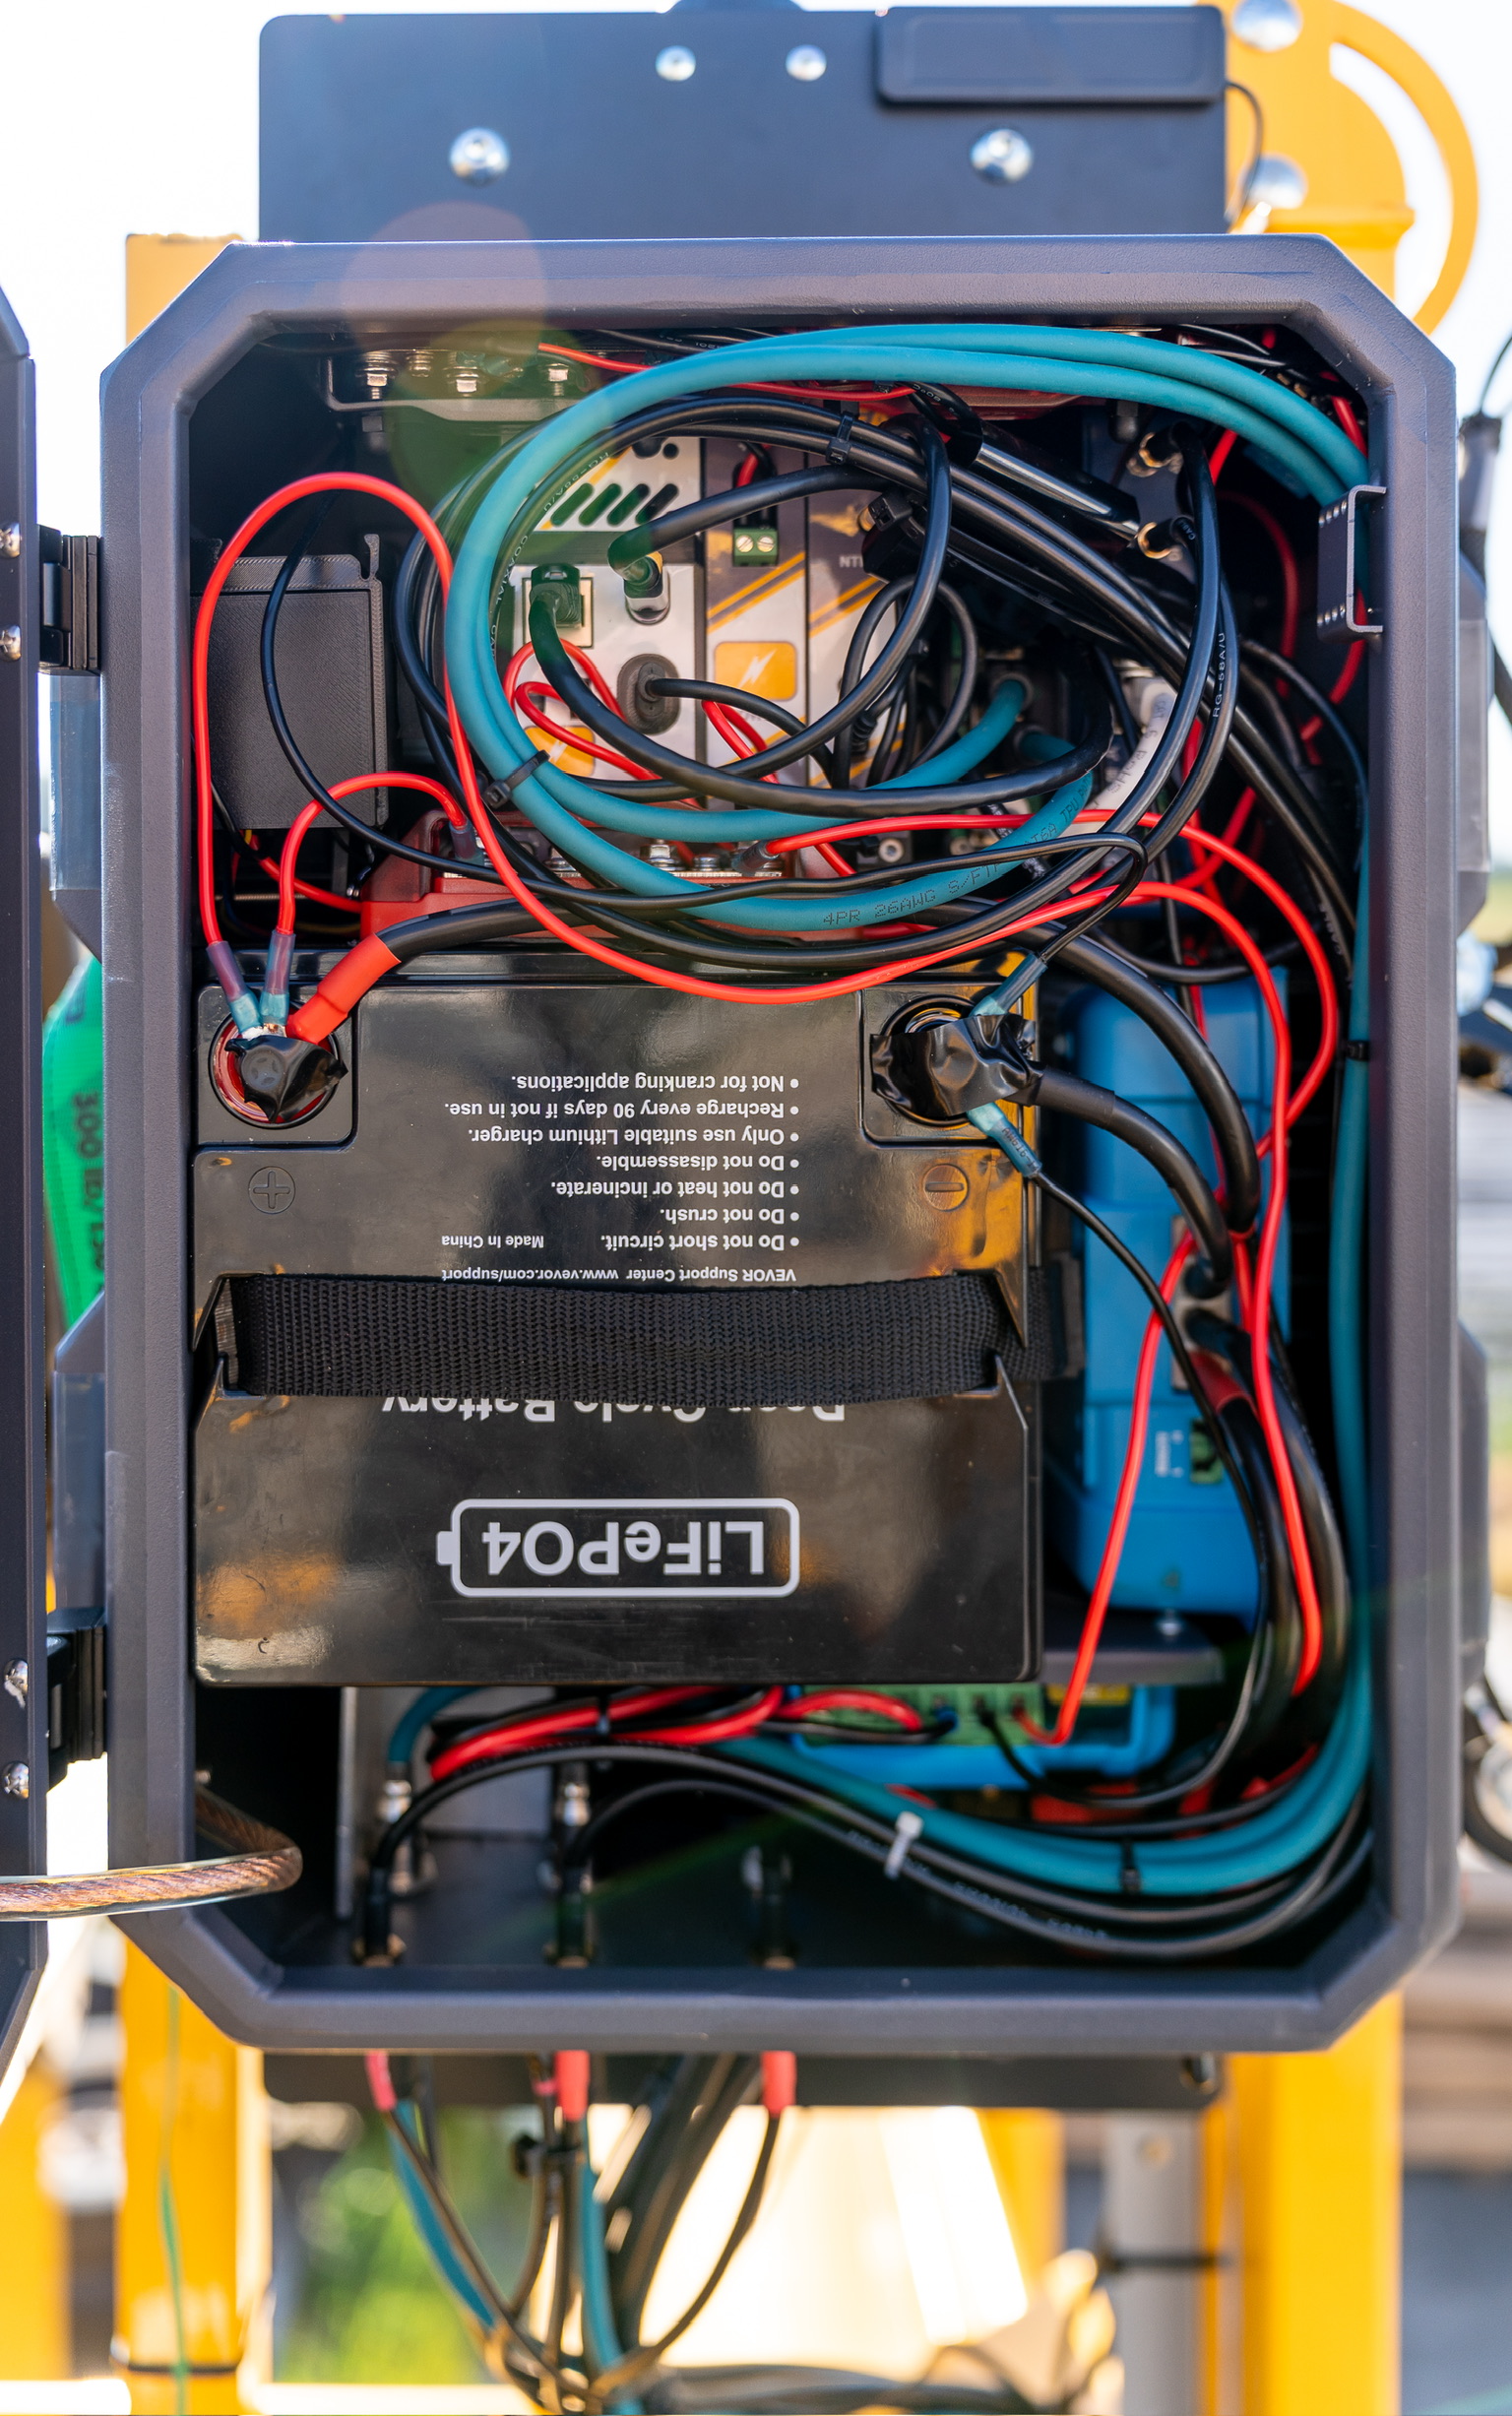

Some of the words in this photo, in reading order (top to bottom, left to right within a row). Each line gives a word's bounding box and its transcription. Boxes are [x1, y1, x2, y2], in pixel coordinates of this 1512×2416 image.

[495, 534, 529, 606] COAXIAL
[1212, 632, 1228, 719] RG-58A/U
[822, 908, 861, 926] 4PR
[873, 888, 936, 920] 26AWG
[1060, 797, 1081, 822] TPU
[511, 1071, 630, 1093] applications.
[634, 1071, 716, 1093] cranking
[720, 1075, 748, 1093] for
[751, 1075, 785, 1093] Not
[444, 1103, 483, 1115] use.
[488, 1103, 506, 1119] in
[510, 1103, 541, 1118] not
[544, 1103, 558, 1119] if
[563, 1099, 608, 1119] days
[612, 1103, 636, 1119] 90
[639, 1099, 691, 1115] every
[695, 1099, 785, 1118] Recharge
[468, 1125, 544, 1146] charger.
[548, 1128, 618, 1146] Lithium
[623, 1128, 698, 1146] suitable
[702, 1128, 736, 1142] use
[740, 1125, 785, 1146] Only
[596, 1155, 719, 1172] disassemble.
[722, 1155, 753, 1171] not
[758, 1155, 785, 1172] Do
[550, 1180, 648, 1199] incinerate.
[652, 1180, 673, 1195] or
[676, 1180, 718, 1199] heat
[722, 1180, 753, 1198] not
[758, 1180, 785, 1199] Do
[660, 1208, 719, 1225] crush.
[722, 1208, 753, 1224] not
[758, 1208, 785, 1225] Do
[441, 1235, 484, 1249] China
[487, 1235, 502, 1249] In
[504, 1235, 544, 1249] Made
[600, 1235, 664, 1252] circuit.
[668, 1235, 719, 1251] short
[723, 1235, 754, 1251] not
[758, 1234, 785, 1251] Do
[441, 1266, 619, 1283] www.vevor.com/support
[625, 1268, 676, 1283] Center
[678, 1265, 739, 1283] Support
[741, 1268, 797, 1283] VEVOR
[482, 1521, 764, 1575] LiFePO4
